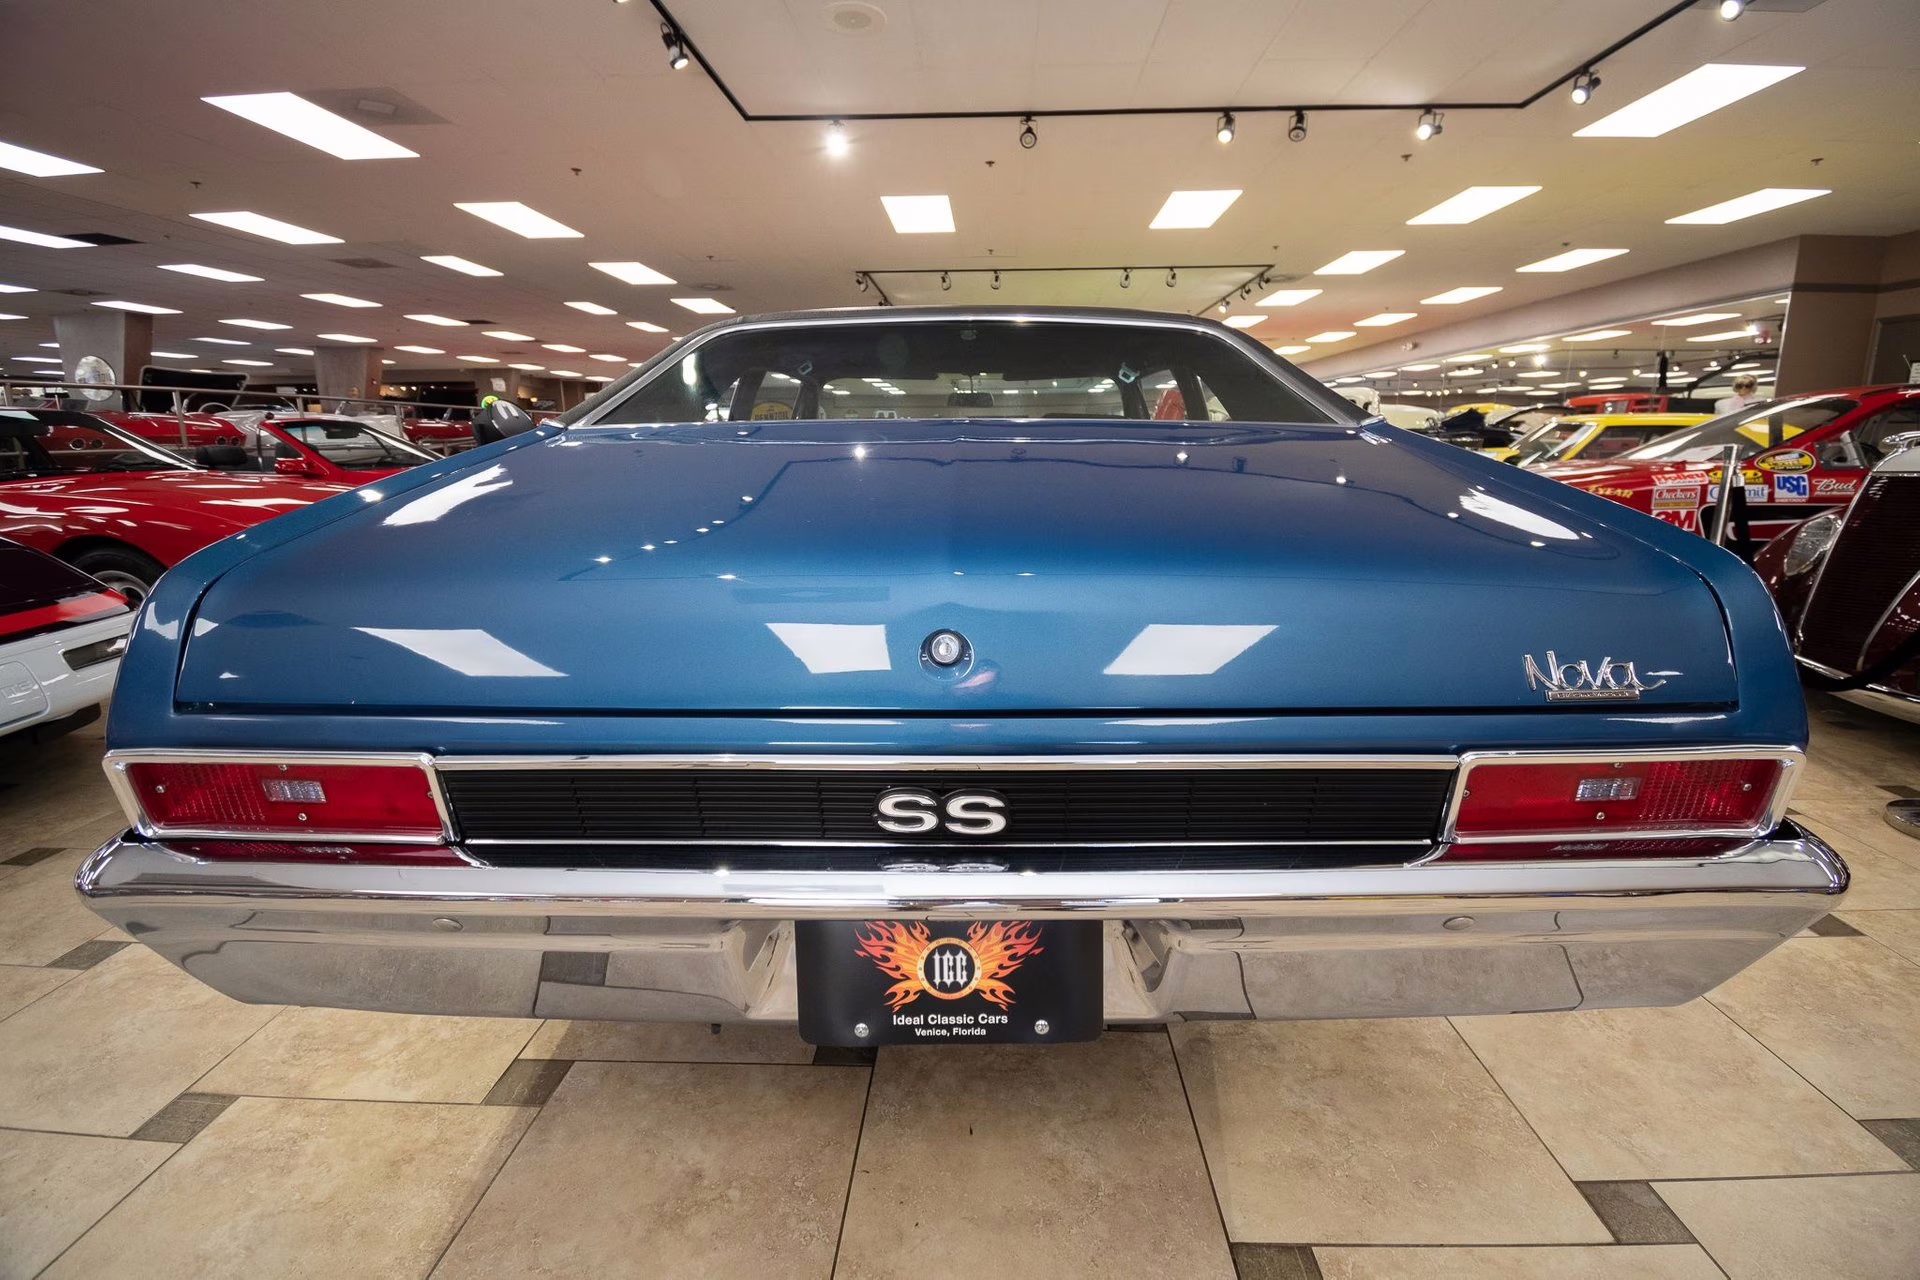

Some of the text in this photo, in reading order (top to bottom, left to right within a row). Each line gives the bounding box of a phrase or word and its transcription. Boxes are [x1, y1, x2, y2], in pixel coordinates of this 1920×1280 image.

[1776, 475, 1807, 497] USG
[1812, 478, 1856, 493] Bud
[1655, 490, 1697, 500] Checkers
[1523, 650, 1667, 691] Nova
[877, 793, 1007, 835] SS
[893, 1013, 1009, 1025] Ideal Classic Cars
[914, 1027, 987, 1037] Venice, Florida
